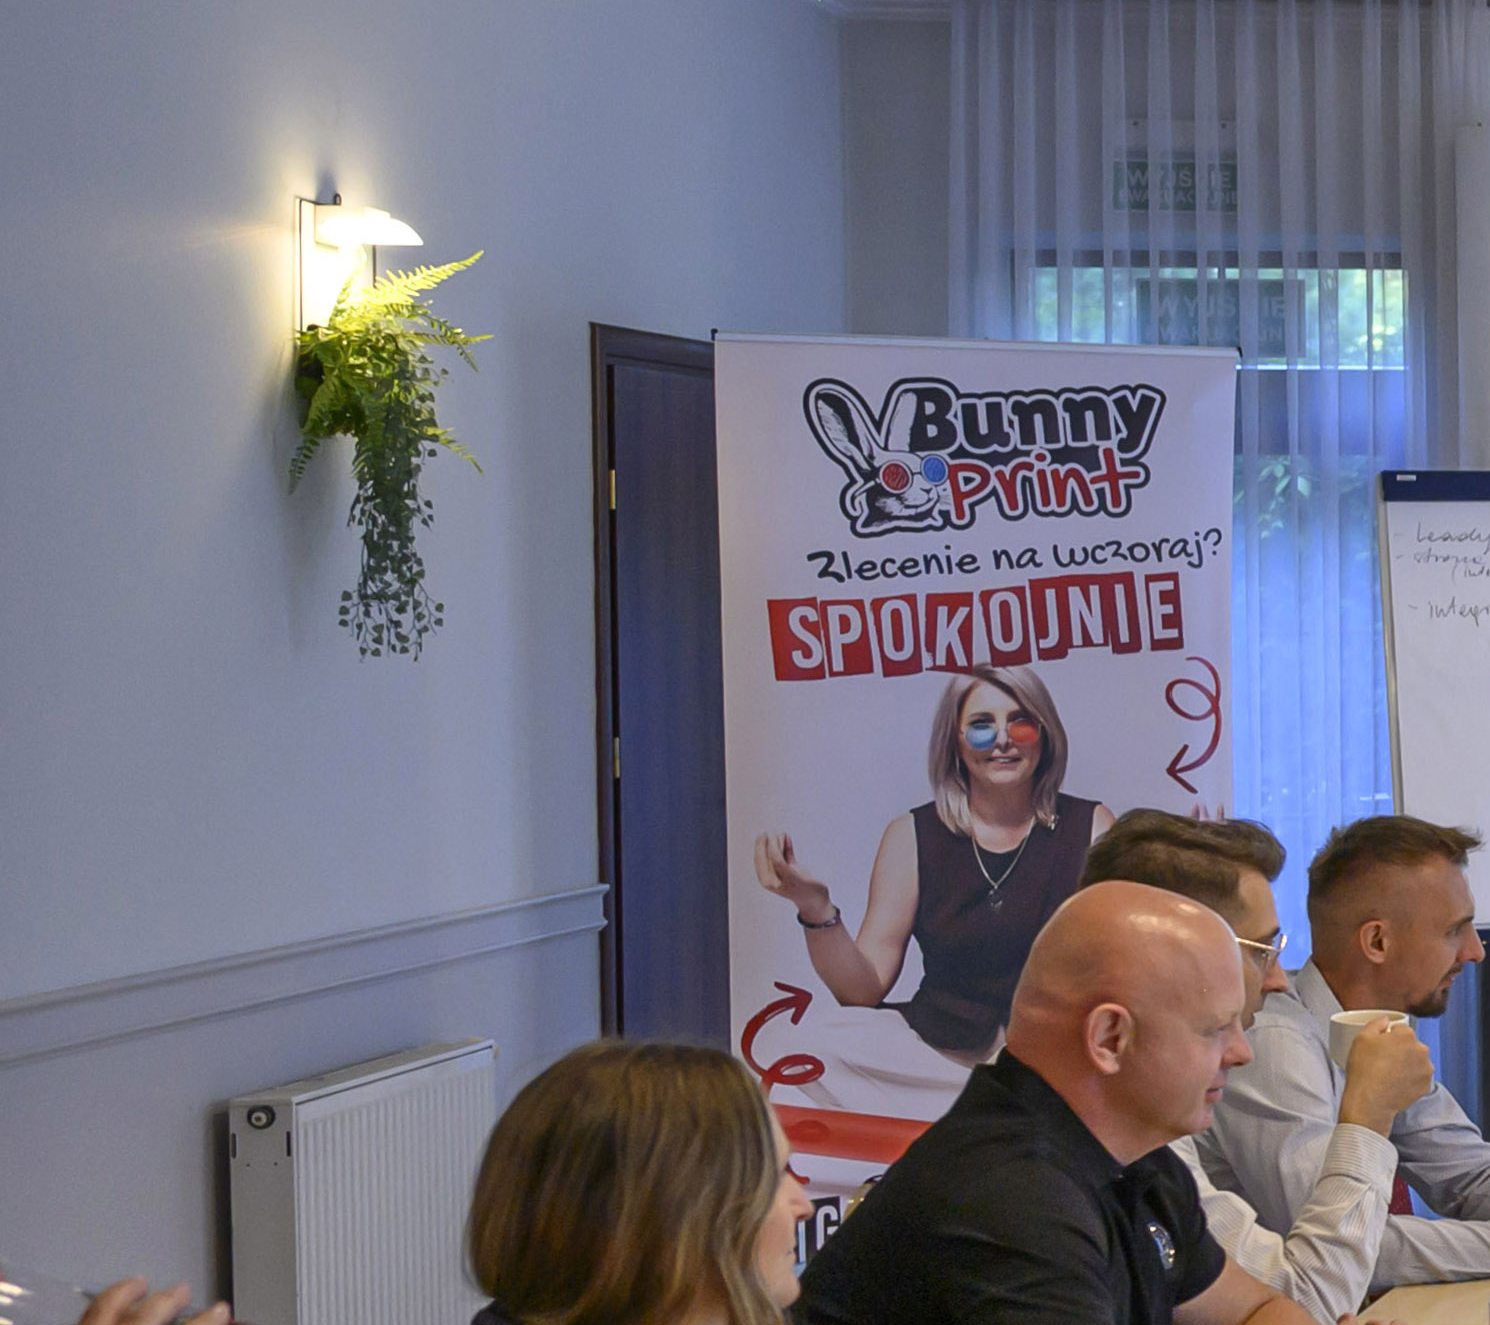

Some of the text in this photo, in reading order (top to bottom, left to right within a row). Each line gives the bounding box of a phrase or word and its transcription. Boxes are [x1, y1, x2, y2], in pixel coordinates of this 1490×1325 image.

[909, 385, 1158, 455] Bunny
[807, 528, 1224, 583] Zlecenie na wczoraj?
[786, 579, 1181, 672] SPOKOJNIE
